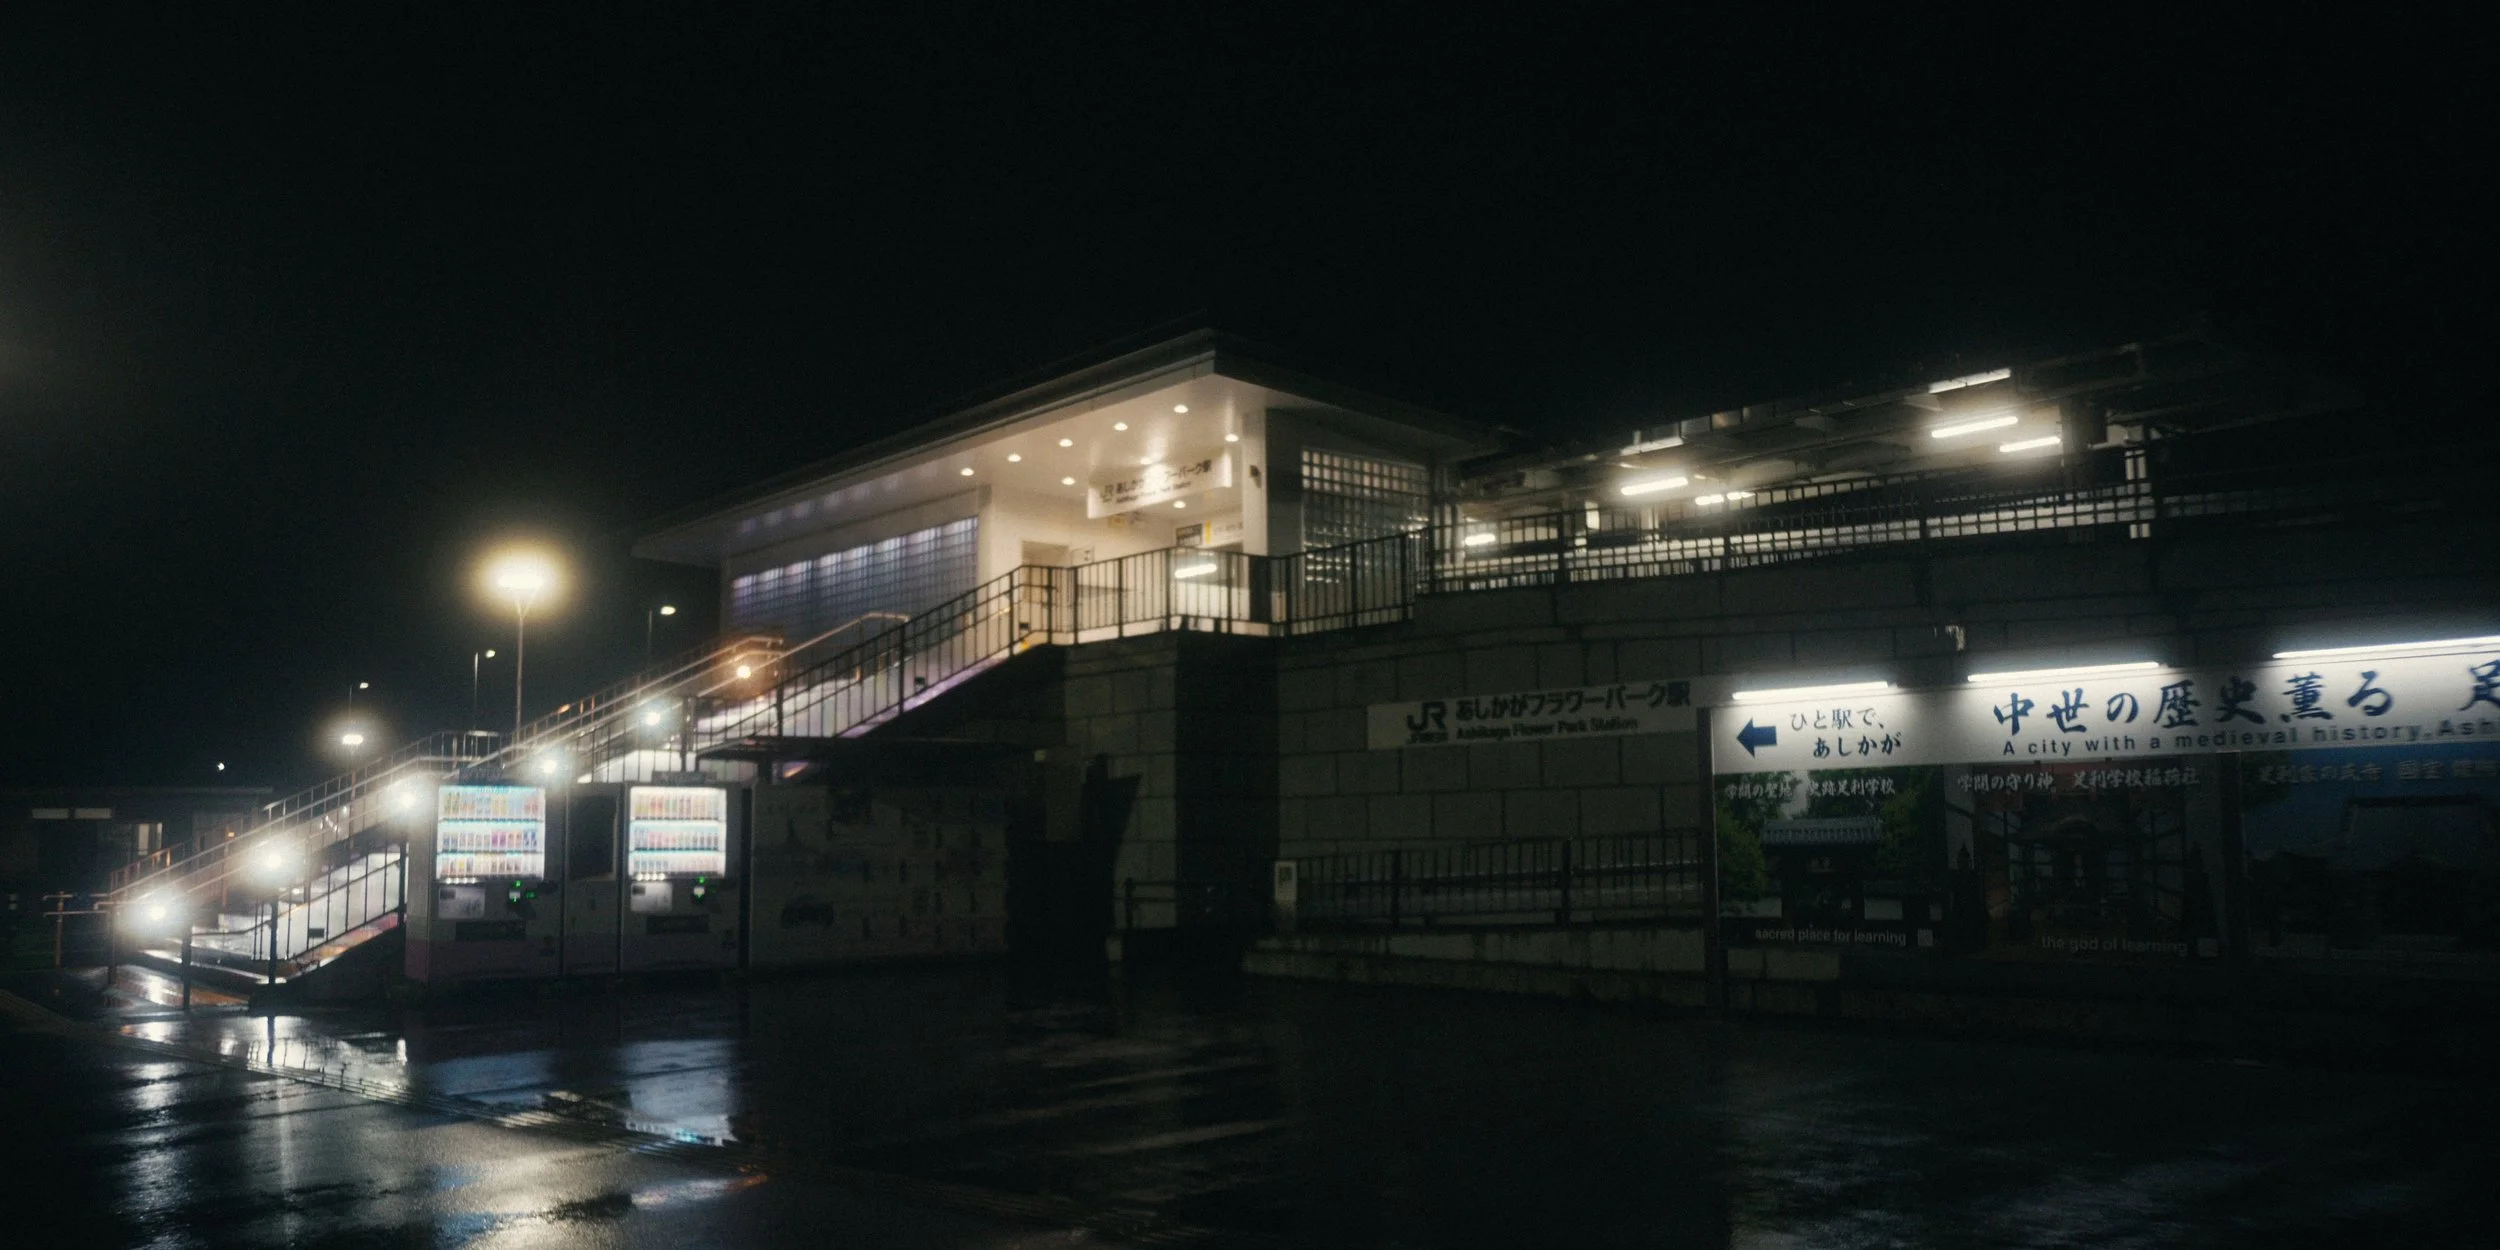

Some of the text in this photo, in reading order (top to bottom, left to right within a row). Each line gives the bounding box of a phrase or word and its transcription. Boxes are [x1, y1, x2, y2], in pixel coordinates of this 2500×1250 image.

[1406, 680, 1691, 731] JR あしかがフラワーパーク駅
[1813, 731, 1902, 759] あしかが
[2003, 740, 2015, 756] A
[2028, 737, 2071, 757] city
[2085, 734, 2136, 751] with
[2150, 737, 2161, 750] a
[2175, 727, 2298, 749] medieval
[1755, 928, 1907, 947] sacred place for learning
[2041, 936, 2189, 958] the god of learning
